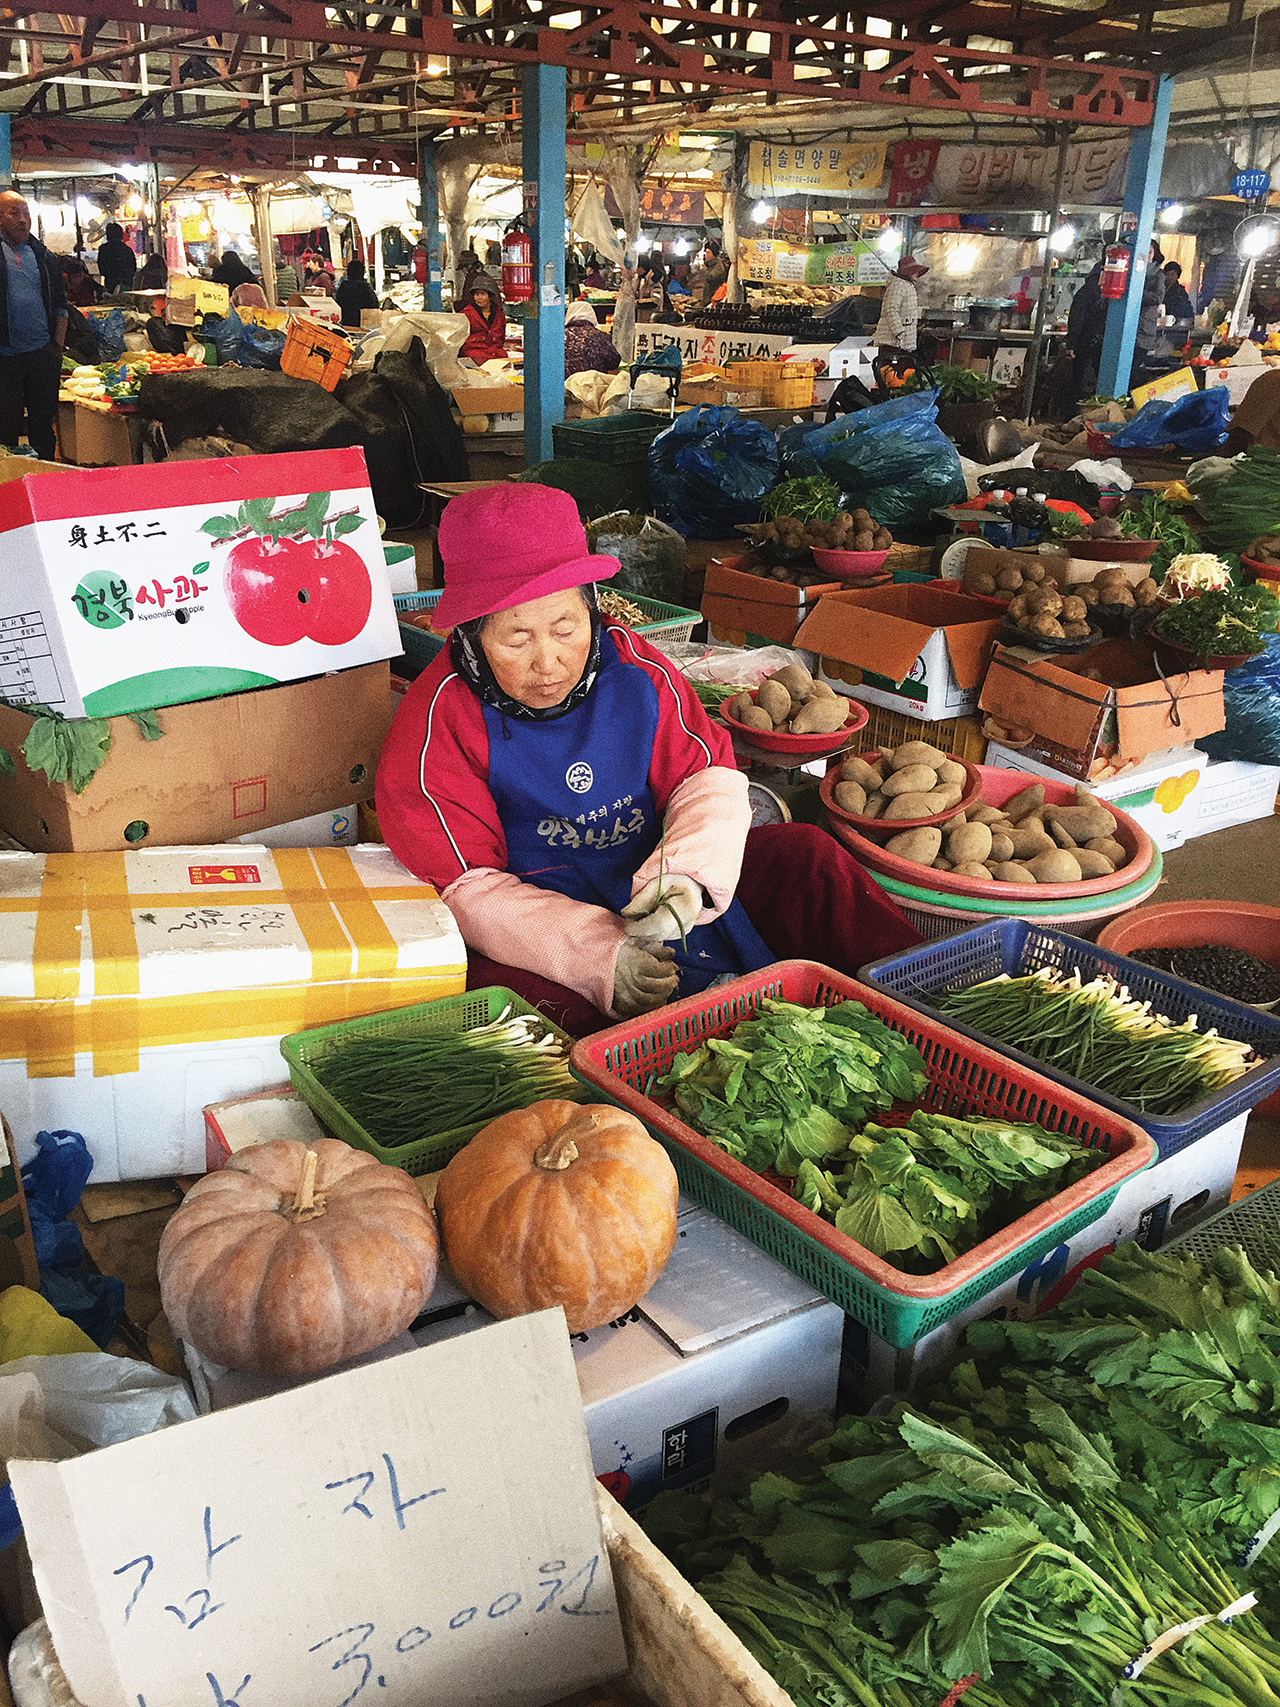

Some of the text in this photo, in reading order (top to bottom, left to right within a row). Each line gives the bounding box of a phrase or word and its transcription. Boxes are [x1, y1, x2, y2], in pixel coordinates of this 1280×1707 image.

[1236, 174, 1266, 187] 18-117
[825, 270, 855, 284] 쌀조청
[68, 521, 168, 549] 身土不二
